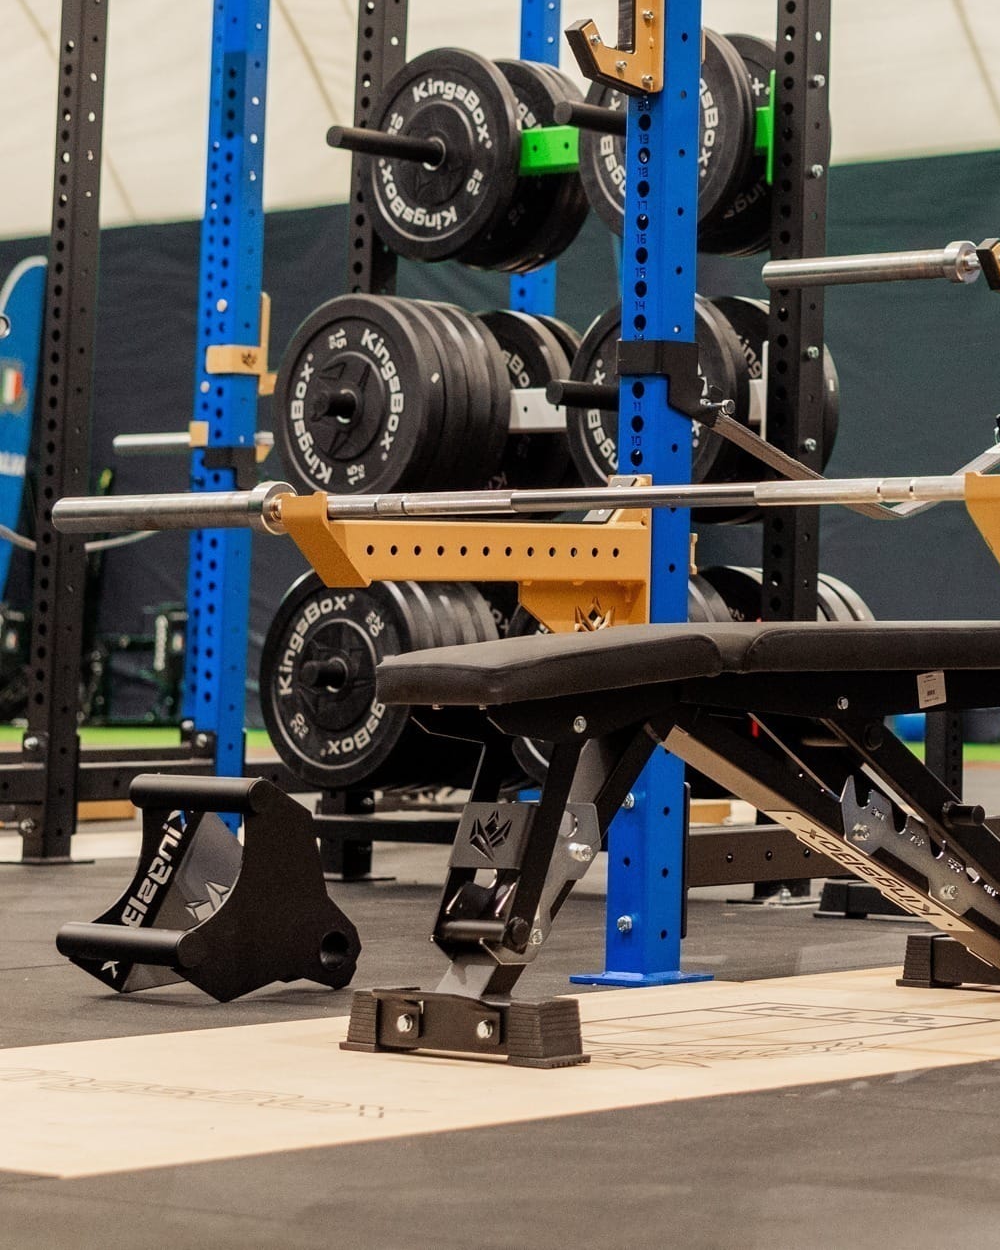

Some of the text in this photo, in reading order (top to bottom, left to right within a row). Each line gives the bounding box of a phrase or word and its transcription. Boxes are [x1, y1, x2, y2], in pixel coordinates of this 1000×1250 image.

[390, 112, 404, 130] 10
[381, 164, 458, 231] KingsBox
[466, 178, 481, 196] 10
[291, 362, 333, 484] KingsBox
[361, 328, 404, 451] KingsBox
[279, 596, 347, 696] KingsBox
